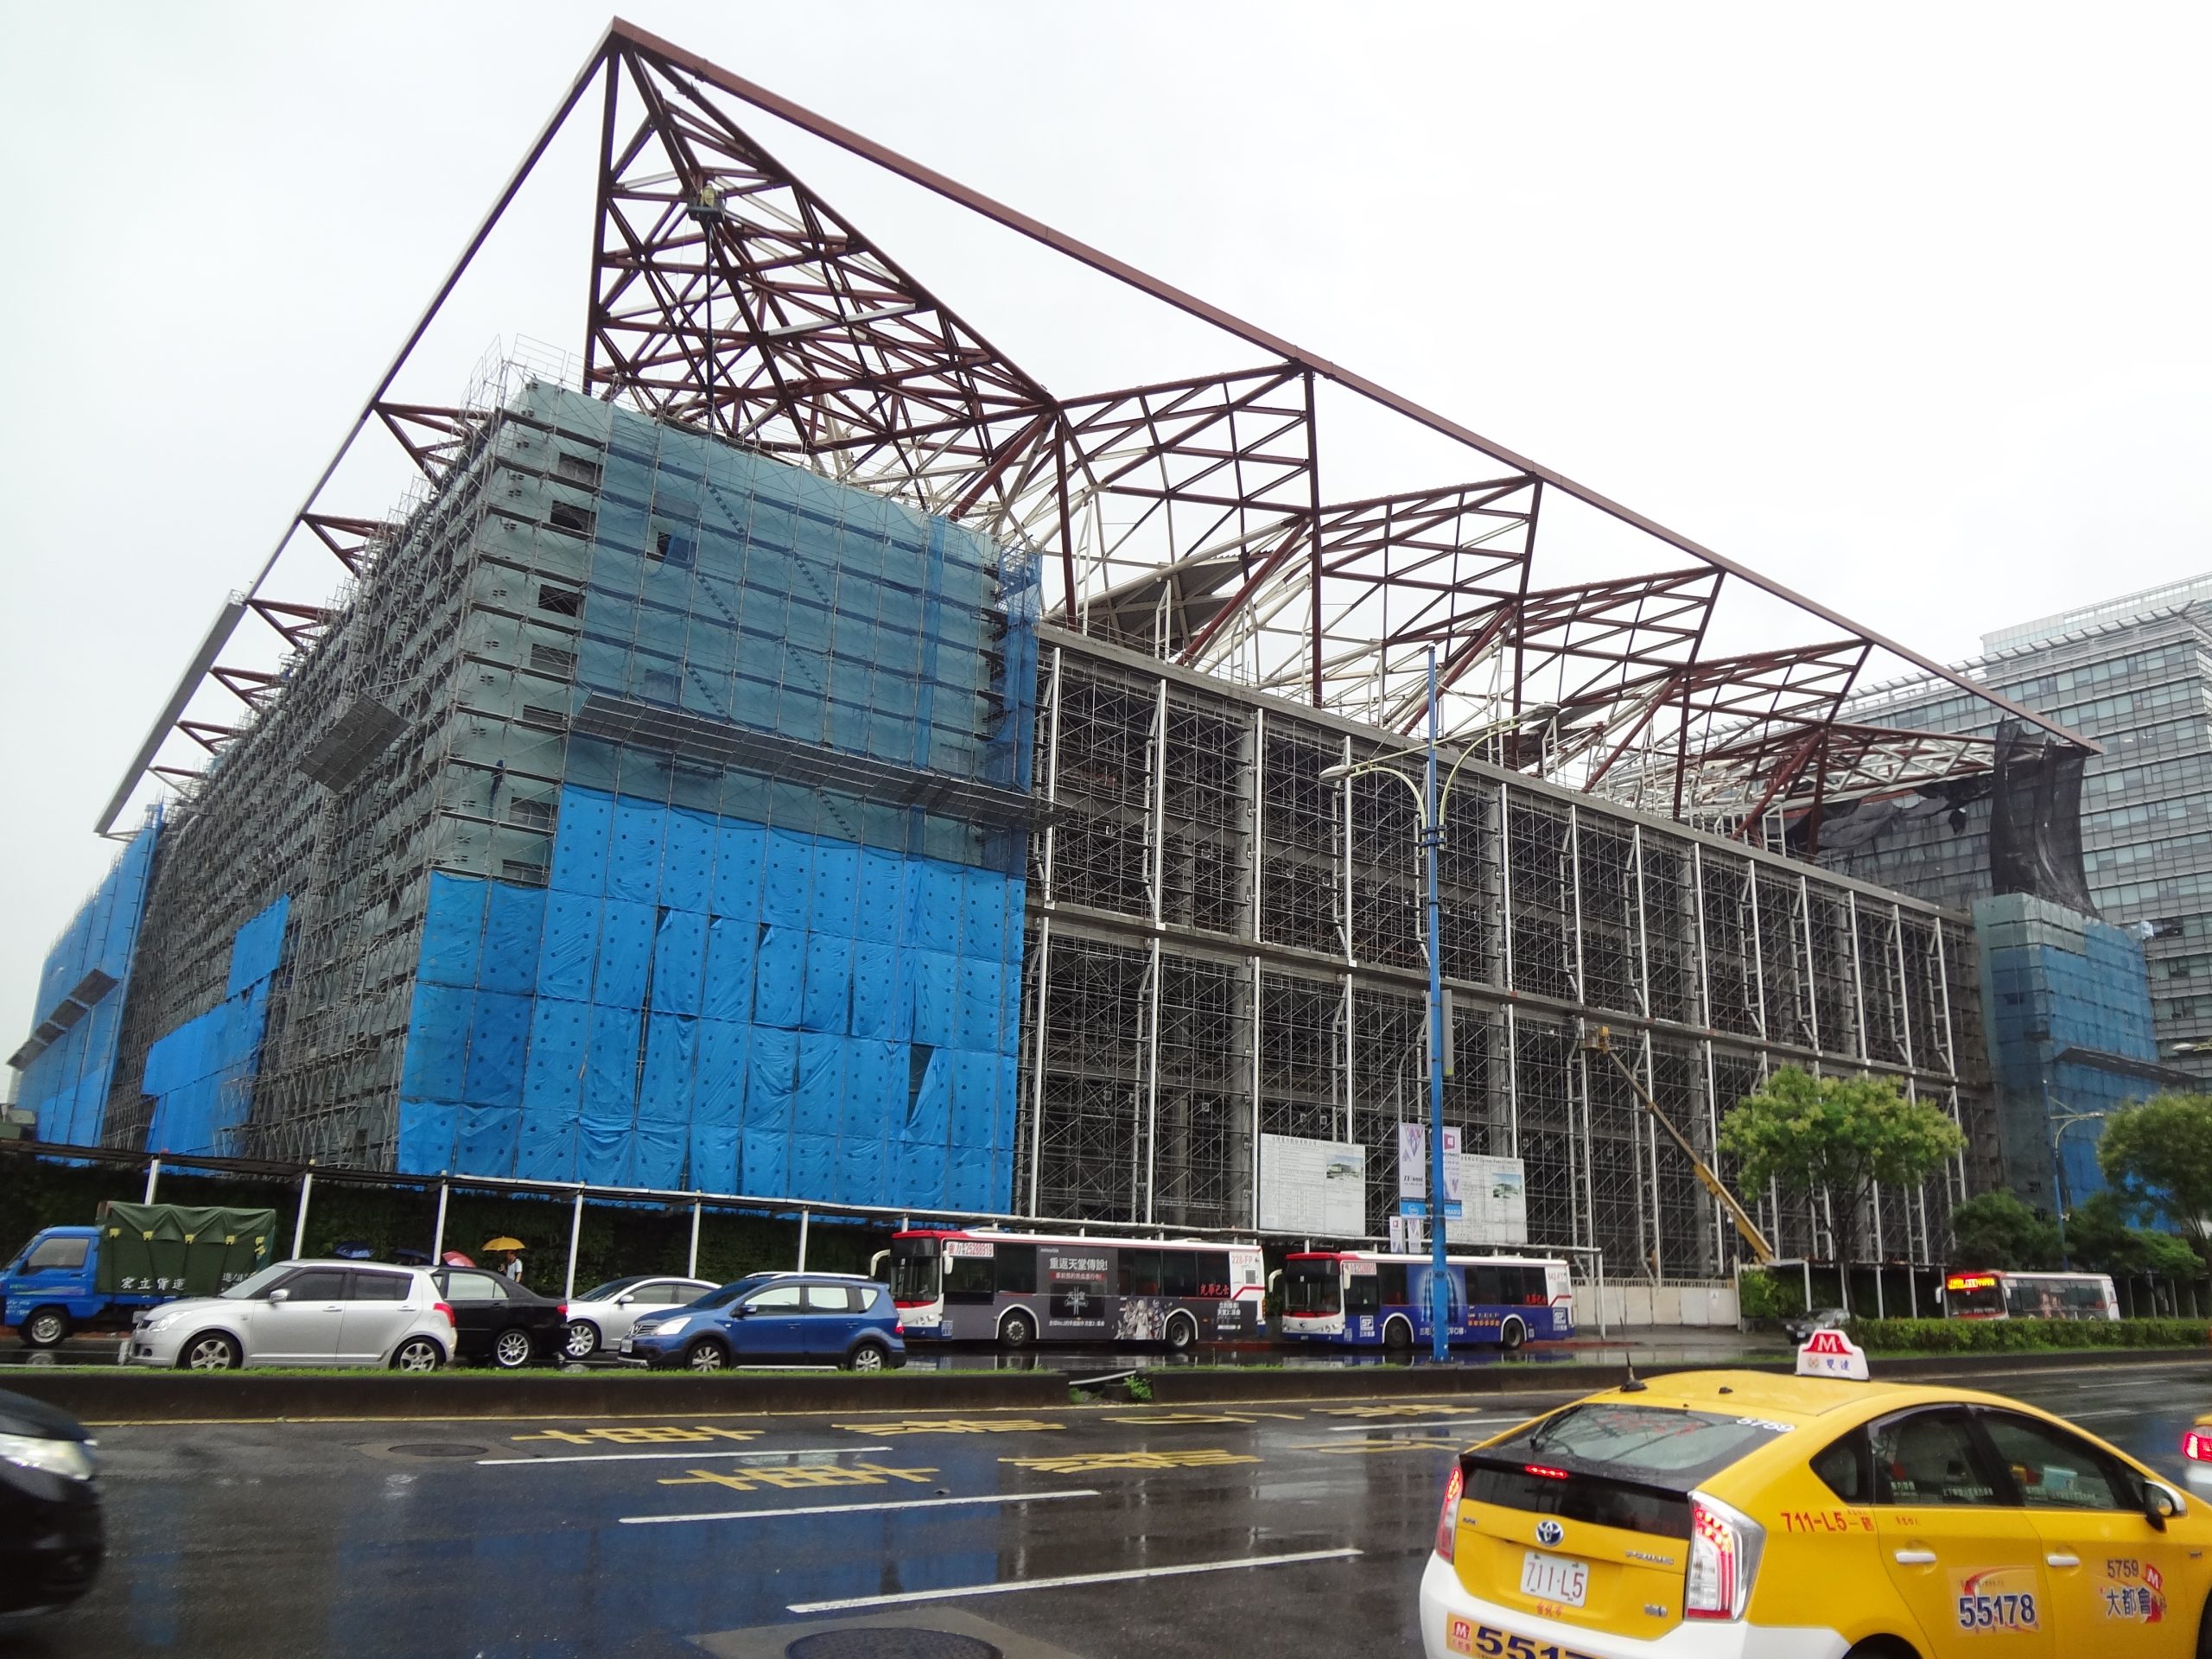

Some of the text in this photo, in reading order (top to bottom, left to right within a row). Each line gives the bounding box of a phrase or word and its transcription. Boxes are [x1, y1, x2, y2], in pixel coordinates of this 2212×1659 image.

[1049, 1257, 1108, 1271] 重返天堂傳說!
[1817, 1335, 1838, 1351] M
[1736, 1415, 1796, 1433] 5759
[2107, 1560, 2139, 1579] 5759
[2146, 1568, 2160, 1591] M
[1959, 1594, 2037, 1629] 55178
[2106, 1587, 2152, 1617] 大都會
[1455, 1623, 1468, 1638] M
[1476, 1625, 1599, 1659] 55
